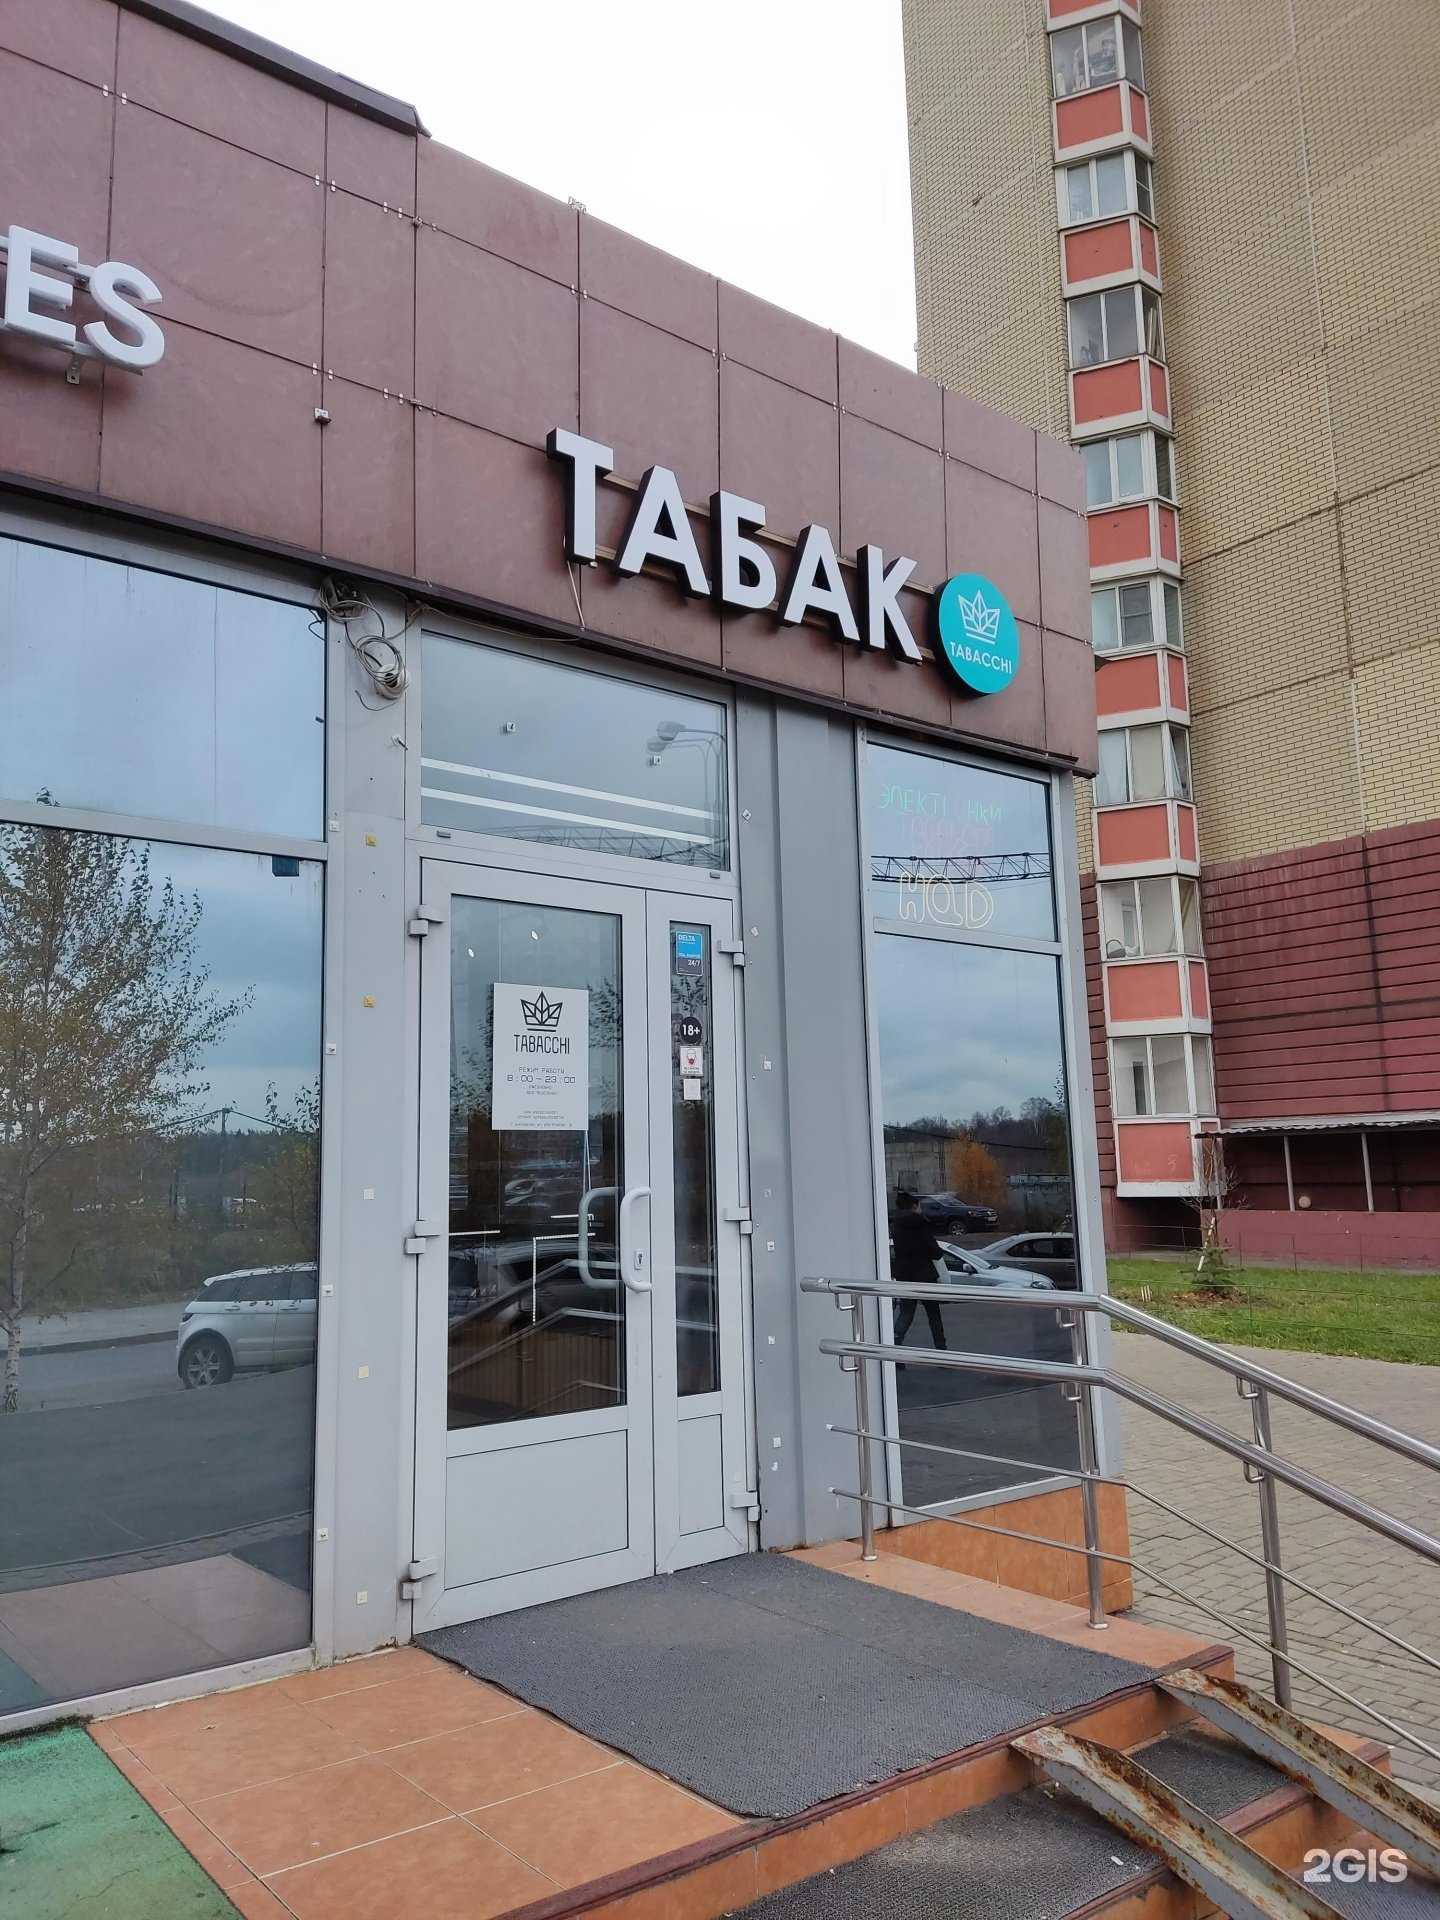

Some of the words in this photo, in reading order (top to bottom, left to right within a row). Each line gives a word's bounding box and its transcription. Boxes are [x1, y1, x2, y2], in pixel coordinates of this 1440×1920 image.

[547, 427, 923, 662] ТАБАК
[950, 641, 1012, 674] TABACCHI
[898, 870, 994, 929] HQD
[513, 1034, 570, 1055] TABACCHI
[682, 1024, 701, 1036] 18+
